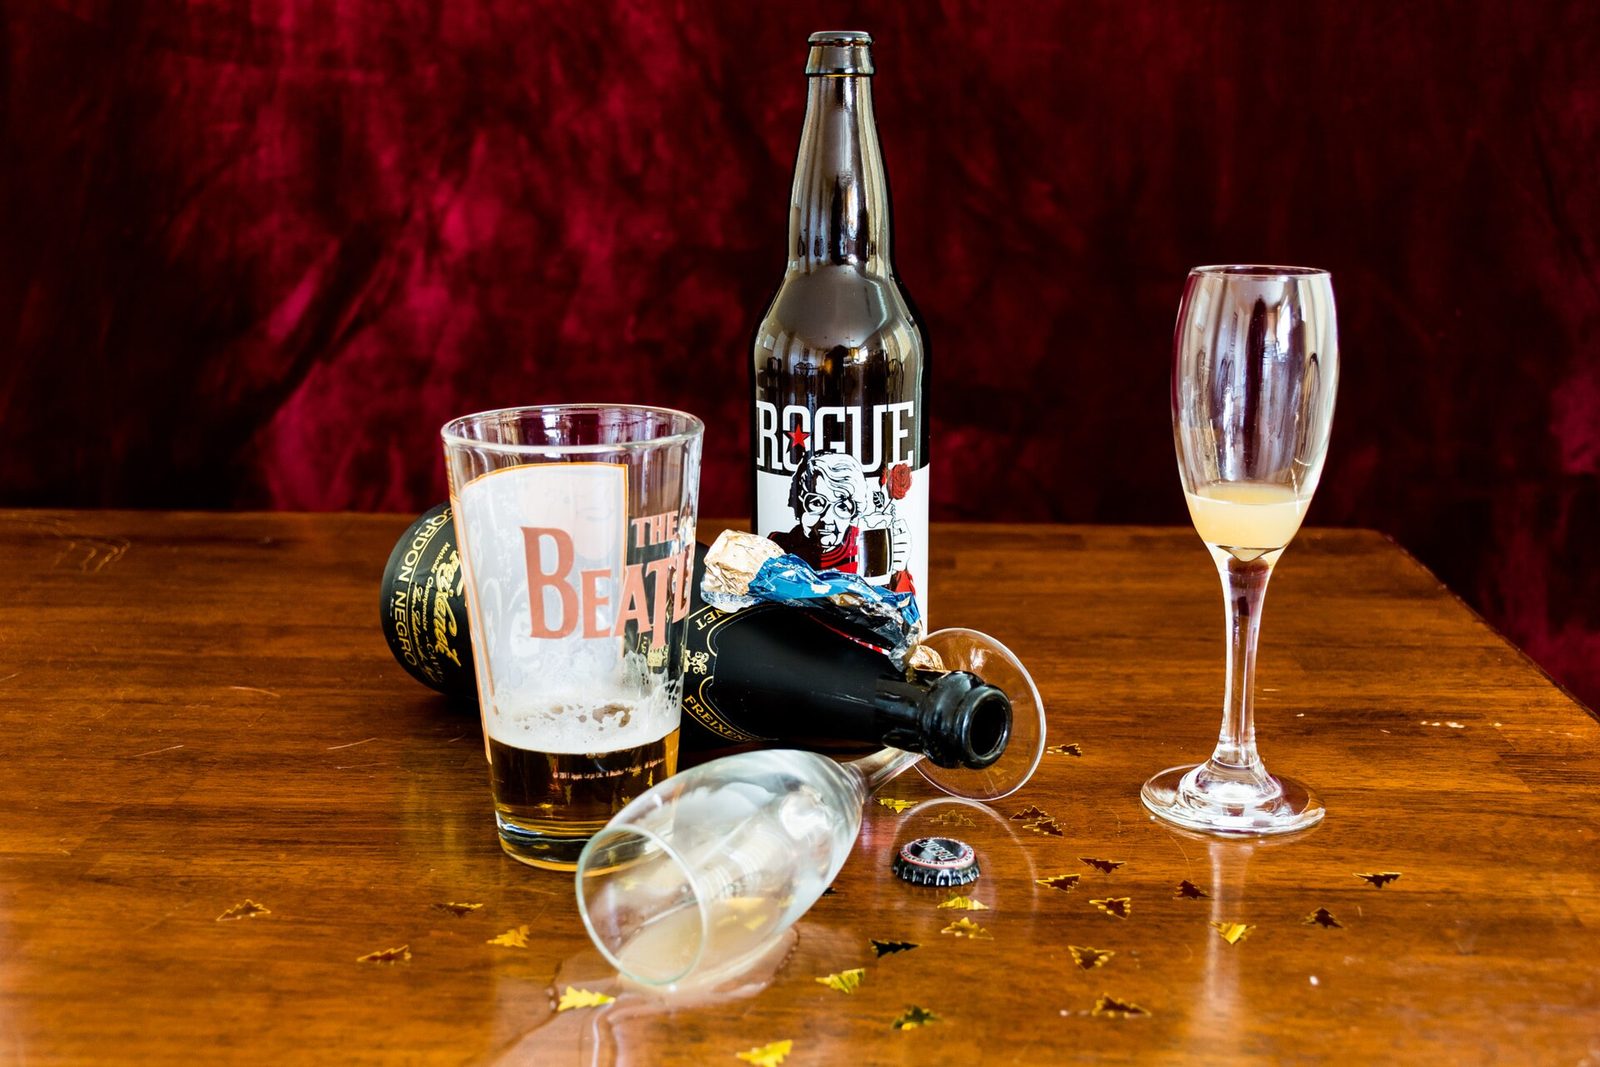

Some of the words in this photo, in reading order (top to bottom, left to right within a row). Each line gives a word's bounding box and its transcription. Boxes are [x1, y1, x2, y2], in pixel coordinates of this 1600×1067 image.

[756, 400, 914, 472] ROGUE
[631, 510, 680, 548] THE
[394, 591, 417, 666] NEGRO
